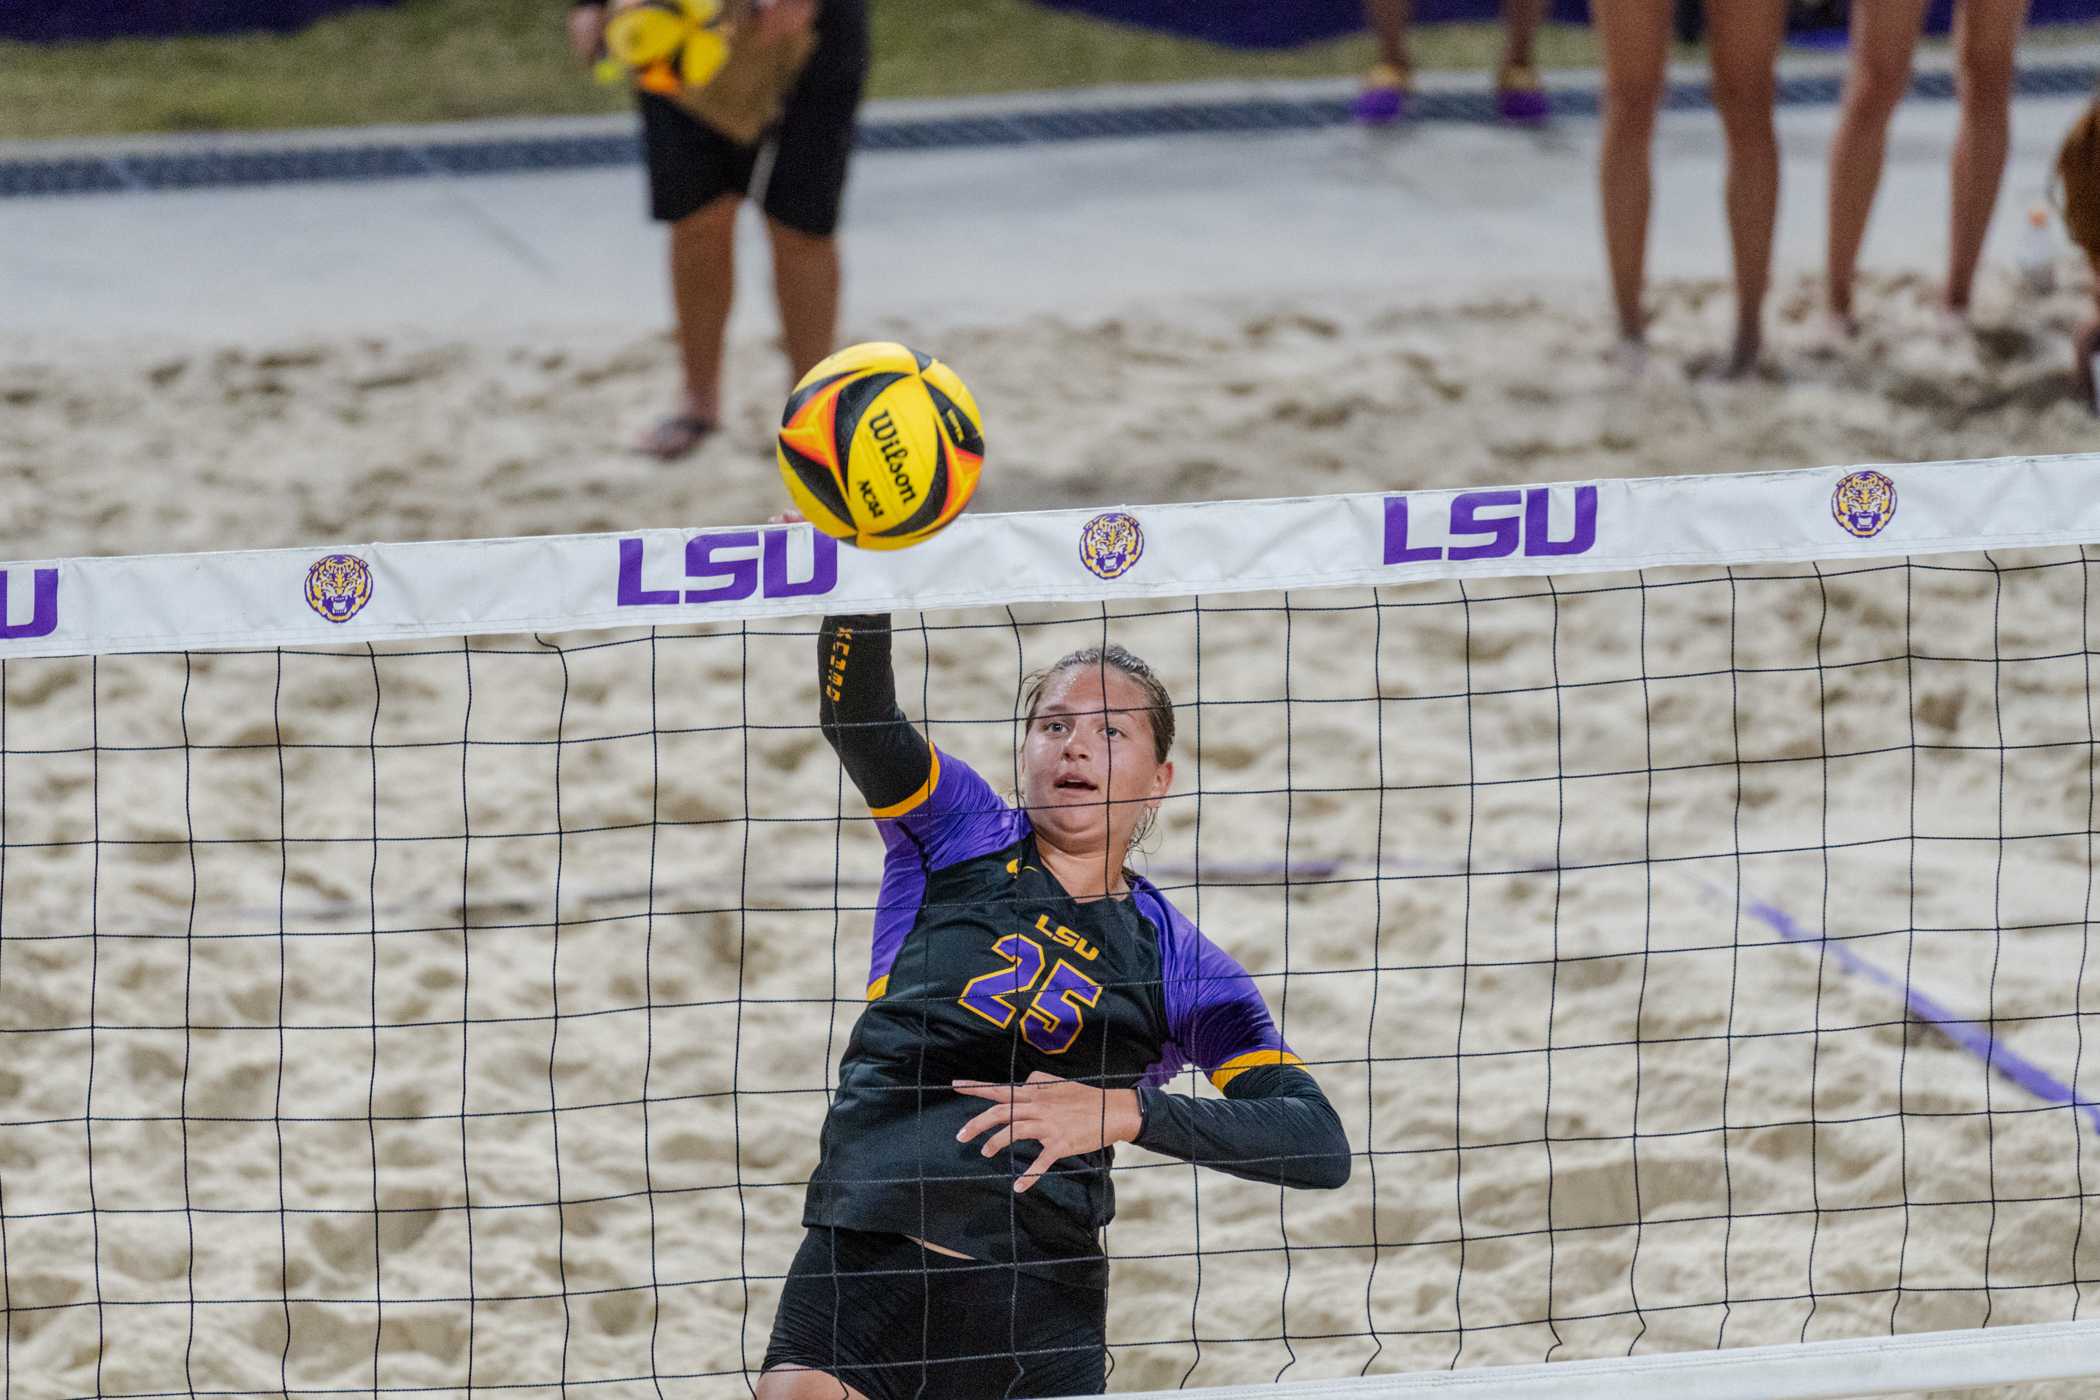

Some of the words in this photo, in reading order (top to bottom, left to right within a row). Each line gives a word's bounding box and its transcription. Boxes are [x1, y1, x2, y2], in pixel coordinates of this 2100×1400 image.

[868, 408, 917, 504] Wilson
[1384, 486, 1598, 565] LSU
[617, 527, 838, 606] LSU
[1034, 914, 1100, 961] LSU
[958, 932, 1104, 1055] 25
